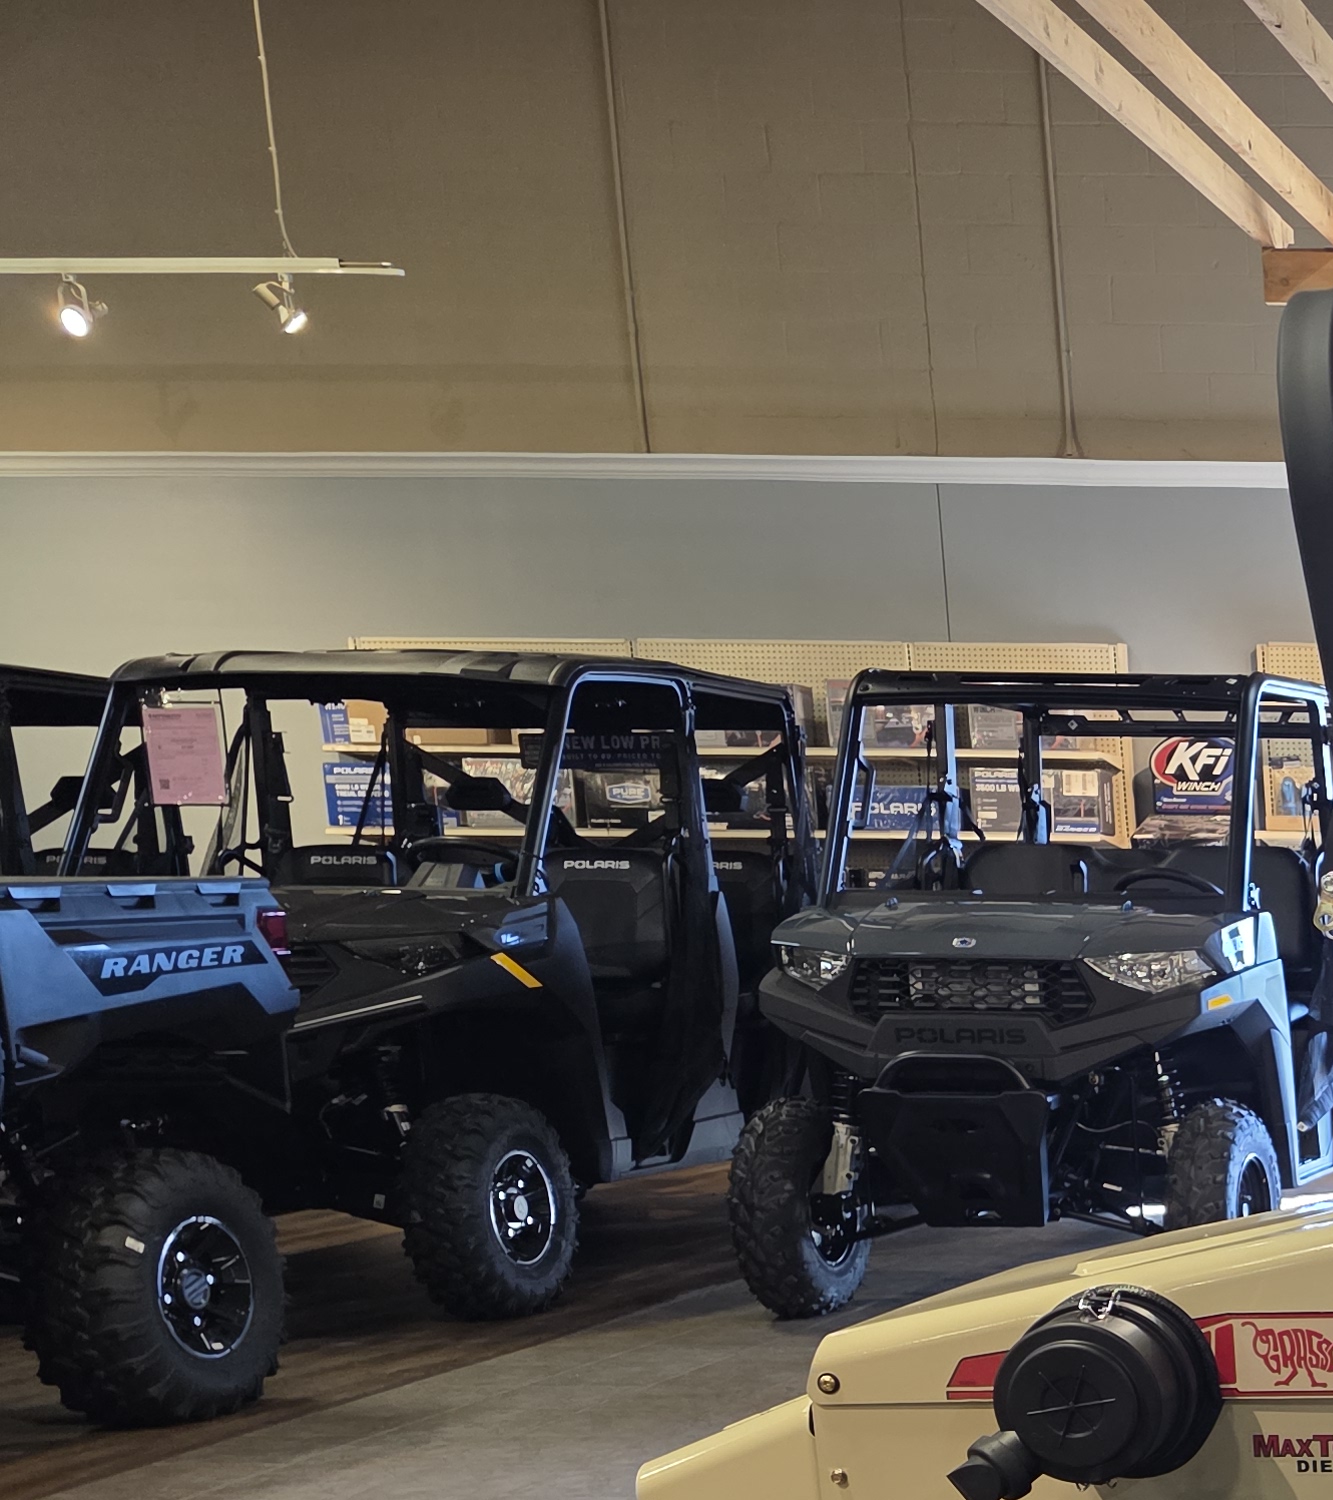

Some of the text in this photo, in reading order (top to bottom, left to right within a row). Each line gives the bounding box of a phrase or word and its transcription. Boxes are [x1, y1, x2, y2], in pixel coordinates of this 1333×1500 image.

[612, 787, 645, 797] PURE
[310, 855, 378, 865] POLARIS
[563, 860, 631, 870] POLARIS
[100, 944, 246, 980] RANGER
[894, 1027, 1027, 1044] POLARIS
